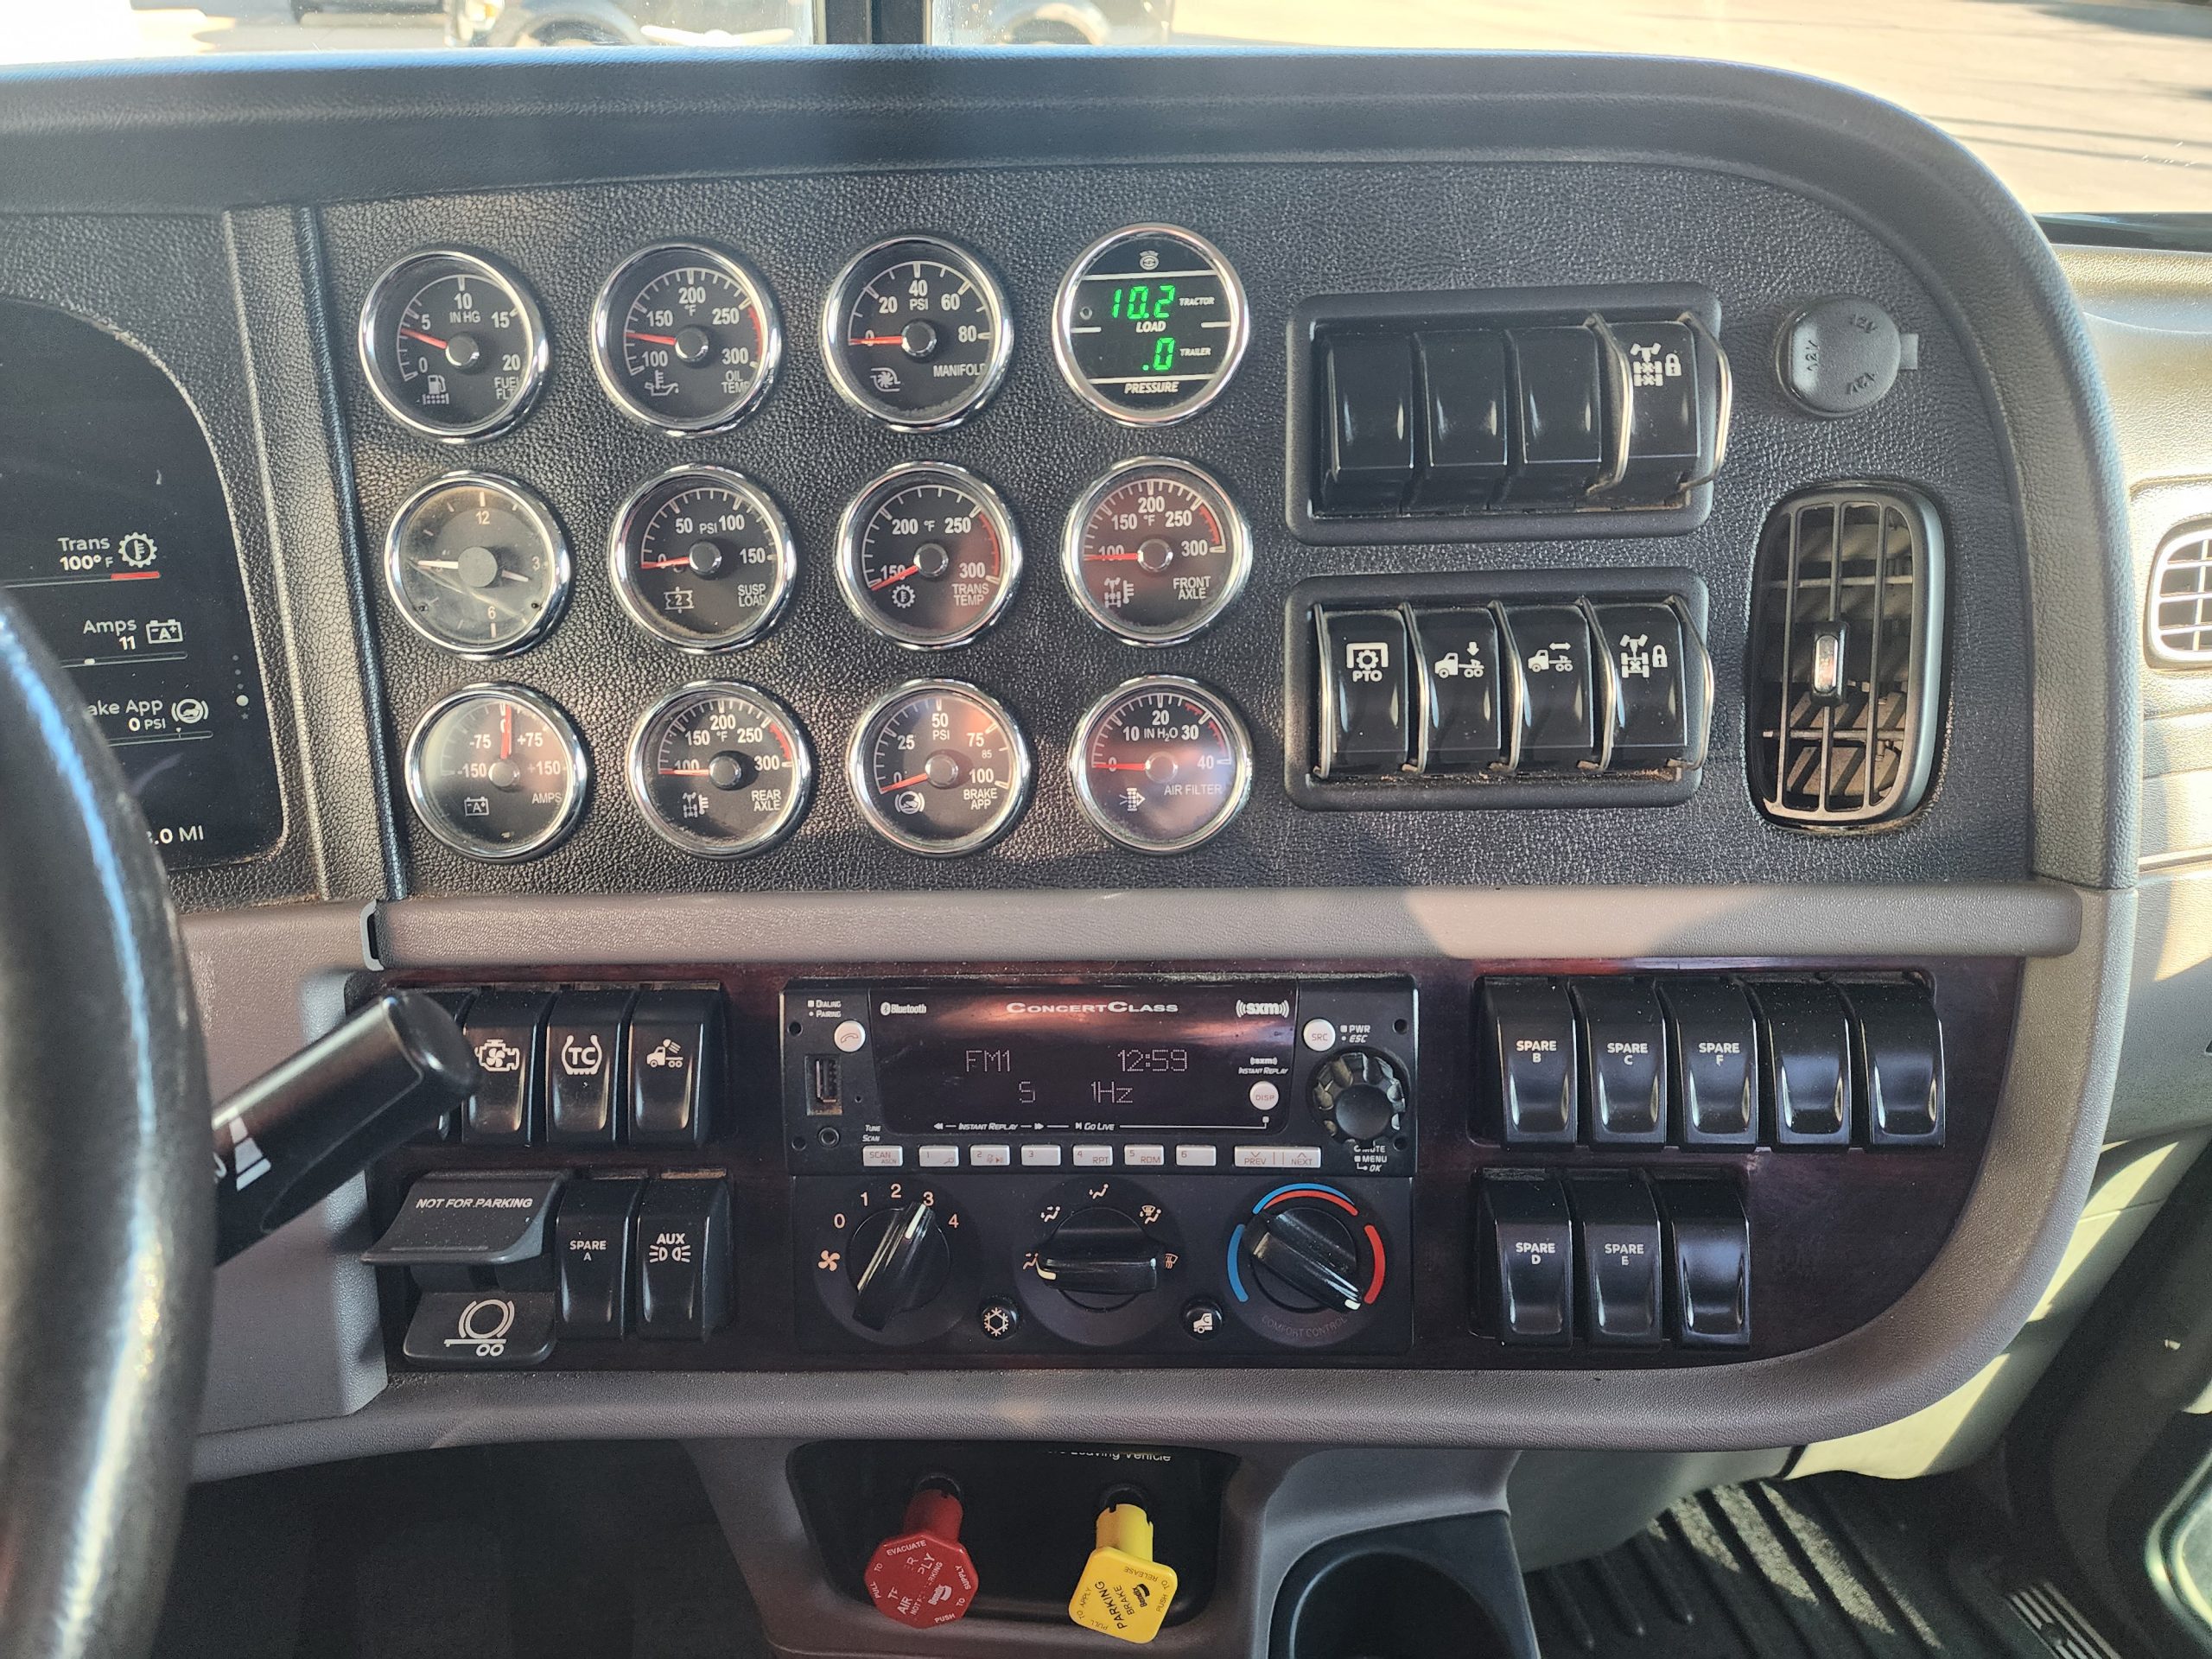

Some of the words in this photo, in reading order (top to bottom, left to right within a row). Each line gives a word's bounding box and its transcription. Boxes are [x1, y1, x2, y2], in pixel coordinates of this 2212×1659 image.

[678, 287, 706, 303] 200
[909, 280, 927, 296] 40
[454, 293, 473, 309] 10
[879, 296, 898, 314] 20
[910, 299, 928, 310] PSI
[941, 293, 960, 310] 60
[1111, 285, 1176, 320] 10.2
[1179, 296, 1215, 307] TRACTOR
[421, 315, 431, 330] 5
[449, 312, 461, 322] IN
[463, 311, 480, 322] HG
[491, 312, 510, 328] 15
[646, 310, 673, 327] 150
[712, 308, 740, 325] 250
[958, 325, 976, 342] 80
[1136, 321, 1166, 334] LOAD
[642, 351, 668, 367] 100
[721, 347, 748, 364] 300
[1179, 347, 1211, 356] TRAILER
[419, 357, 428, 372] 0
[502, 354, 520, 371] 20
[726, 371, 743, 382] OIL
[721, 382, 750, 393] TEMP
[1124, 381, 1179, 394] PRESSURE
[1138, 496, 1165, 513] 200
[475, 511, 491, 525] 12
[676, 518, 692, 533] 50
[719, 514, 745, 531] 100
[944, 518, 971, 533] 250
[1112, 513, 1137, 530] 150
[1165, 510, 1192, 528] 250
[699, 522, 717, 534] PSI
[892, 518, 918, 535] 200
[57, 537, 111, 553] Trans
[1181, 539, 1207, 556] 300
[105, 556, 114, 568] F
[740, 547, 766, 564] 150
[959, 563, 986, 579] 300
[737, 583, 766, 595] SUSP
[951, 583, 989, 594] TRANS
[1173, 576, 1211, 589] FRONT
[739, 594, 766, 607] LOAD
[954, 594, 984, 606] TEMP
[1179, 588, 1206, 600] AXLE
[487, 606, 496, 620] 6
[83, 619, 137, 637] Amps
[118, 635, 137, 651] 11
[1352, 670, 1382, 683] PTO
[125, 699, 163, 716] App
[129, 718, 141, 731] 0
[144, 719, 166, 730] PSI
[710, 714, 735, 731] 200
[931, 713, 949, 728] 50
[1153, 710, 1170, 725] 20
[518, 733, 543, 747] +75
[685, 730, 710, 746] 150
[737, 728, 762, 743] 250
[933, 730, 950, 741] PSI
[966, 733, 985, 747] 75
[1123, 726, 1140, 741] 10
[1144, 728, 1154, 739] IN
[1181, 725, 1199, 740] 30
[470, 734, 491, 749] -75
[898, 734, 915, 750] 25
[982, 750, 992, 759] 85
[528, 760, 561, 775] +150
[754, 755, 779, 771] 300
[1197, 755, 1214, 770] 40
[458, 763, 486, 778] -150
[969, 768, 994, 784] 100
[531, 792, 562, 804] AMPS
[752, 790, 781, 802] REAR
[963, 788, 997, 800] BRAKE
[1164, 785, 1182, 796] AIR
[1185, 785, 1222, 795] FILTER
[753, 800, 780, 811] AXLE
[970, 798, 991, 810] APP
[179, 825, 204, 842] MI
[891, 1004, 926, 1014] Bluetooth
[1516, 1040, 1557, 1052] SPARE
[1606, 1042, 1649, 1054] SPARE
[1699, 1042, 1740, 1054] SPARE
[569, 1047, 596, 1065] TC
[965, 1050, 1011, 1072] FM1
[1117, 1050, 1188, 1072] 12:59
[1532, 1052, 1541, 1064] B
[1624, 1054, 1633, 1065] C
[1715, 1054, 1724, 1066] F
[890, 1183, 902, 1198] 2
[416, 1198, 444, 1209] NOT
[445, 1198, 474, 1208] FOR
[474, 1198, 533, 1209] PARKING
[860, 1192, 868, 1206] 1
[923, 1192, 934, 1206] 3
[834, 1213, 846, 1229] 0
[948, 1213, 959, 1228] 4
[569, 1240, 607, 1250] SPARE
[657, 1233, 685, 1245] AUX
[1516, 1243, 1555, 1254] SPARE
[1604, 1243, 1644, 1255] SPARE
[583, 1252, 592, 1262] A
[1531, 1255, 1541, 1265] D
[1621, 1255, 1630, 1266] E
[1306, 1315, 1348, 1338] CONTROL
[887, 1540, 926, 1556] EVACUATE
[955, 1565, 970, 1590] SUPPLY
[1124, 1567, 1159, 1582] RELEASE
[870, 1581, 881, 1599] PULL
[897, 1596, 913, 1615] AIR
[1095, 1580, 1128, 1630] PARKING
[1114, 1585, 1135, 1616] BRAKE
[1156, 1594, 1167, 1612] PUSH
[934, 1613, 956, 1624] PUSH
